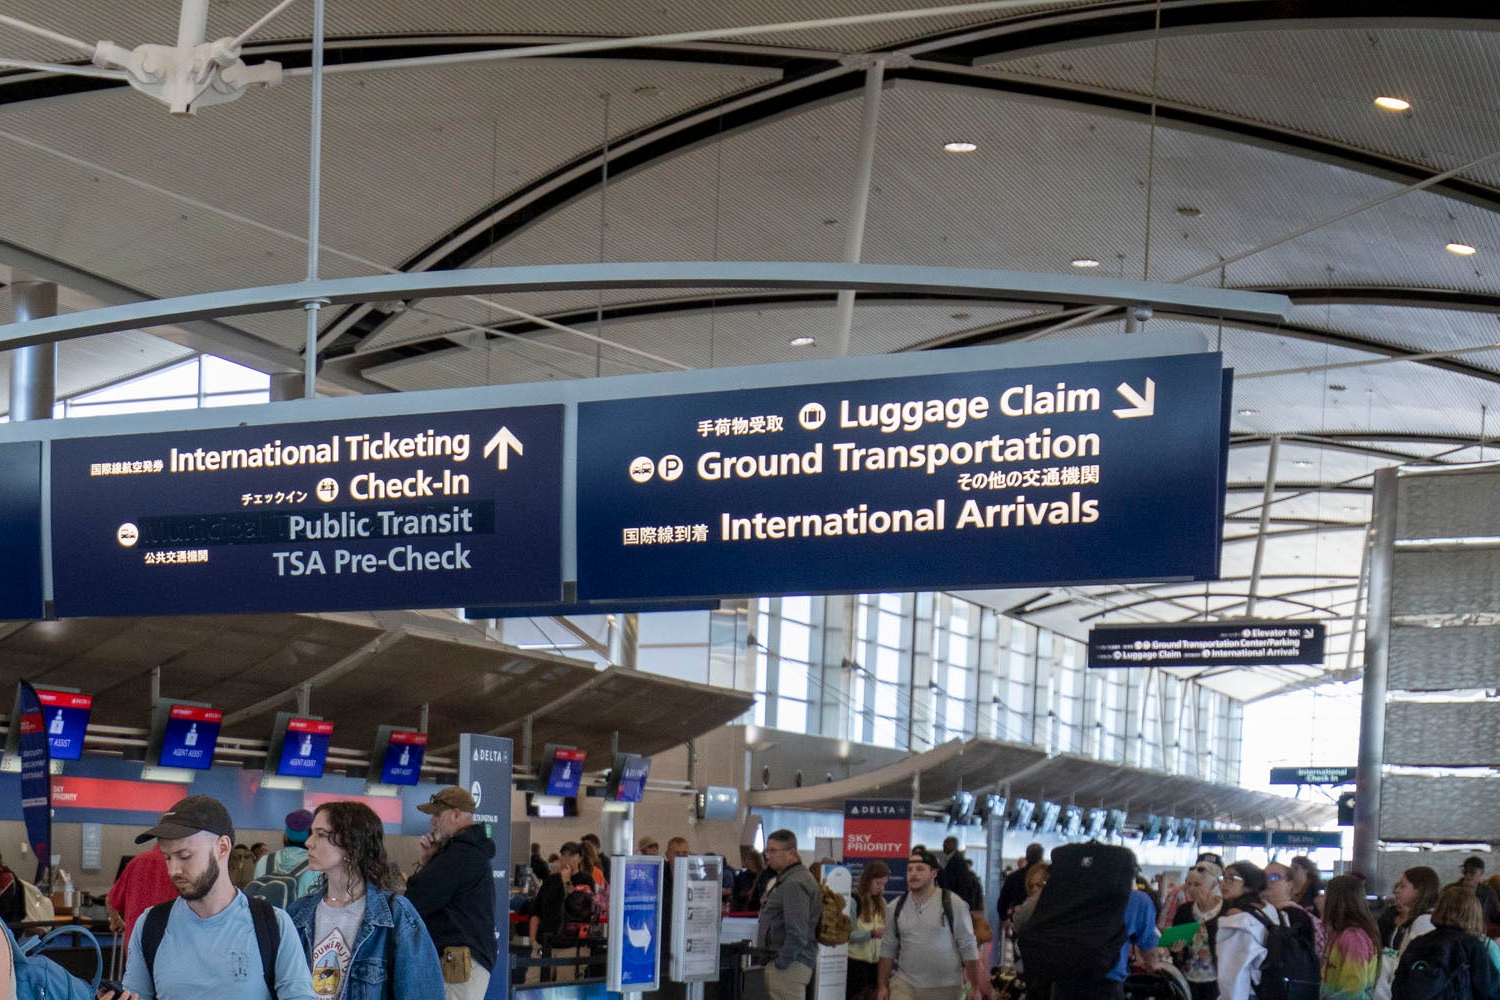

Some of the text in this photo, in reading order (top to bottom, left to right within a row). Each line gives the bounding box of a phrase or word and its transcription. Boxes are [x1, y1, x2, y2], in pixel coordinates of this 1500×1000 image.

[841, 383, 1099, 432] Luggage Claim
[698, 415, 783, 437] 手荷物受取
[171, 430, 469, 472] International Ticketing
[698, 443, 822, 479] Ground
[833, 428, 1099, 474] Transportation
[350, 470, 469, 499] Check-In
[955, 462, 1099, 490] その他の交通機関
[242, 491, 307, 505] チェックイン
[290, 512, 369, 539] Public
[378, 506, 472, 535] Transit
[722, 492, 1099, 540] International Arrivals
[624, 524, 708, 544] 国際線到着
[145, 550, 208, 563] 公共交通機関
[273, 543, 471, 575] TSA Pre-Check
[1252, 629, 1287, 638] Elevator
[1122, 651, 1157, 662] Luggage
[1158, 650, 1182, 659] Claim
[1211, 648, 1266, 657] International
[1267, 648, 1300, 657] Arrivals
[1152, 640, 1182, 650] Ground
[1182, 639, 1239, 650] Transportation
[480, 749, 502, 762] DELTA
[847, 843, 902, 852] PRIORITY
[848, 834, 872, 842] SKY
[313, 941, 347, 962] OUWERIJ
